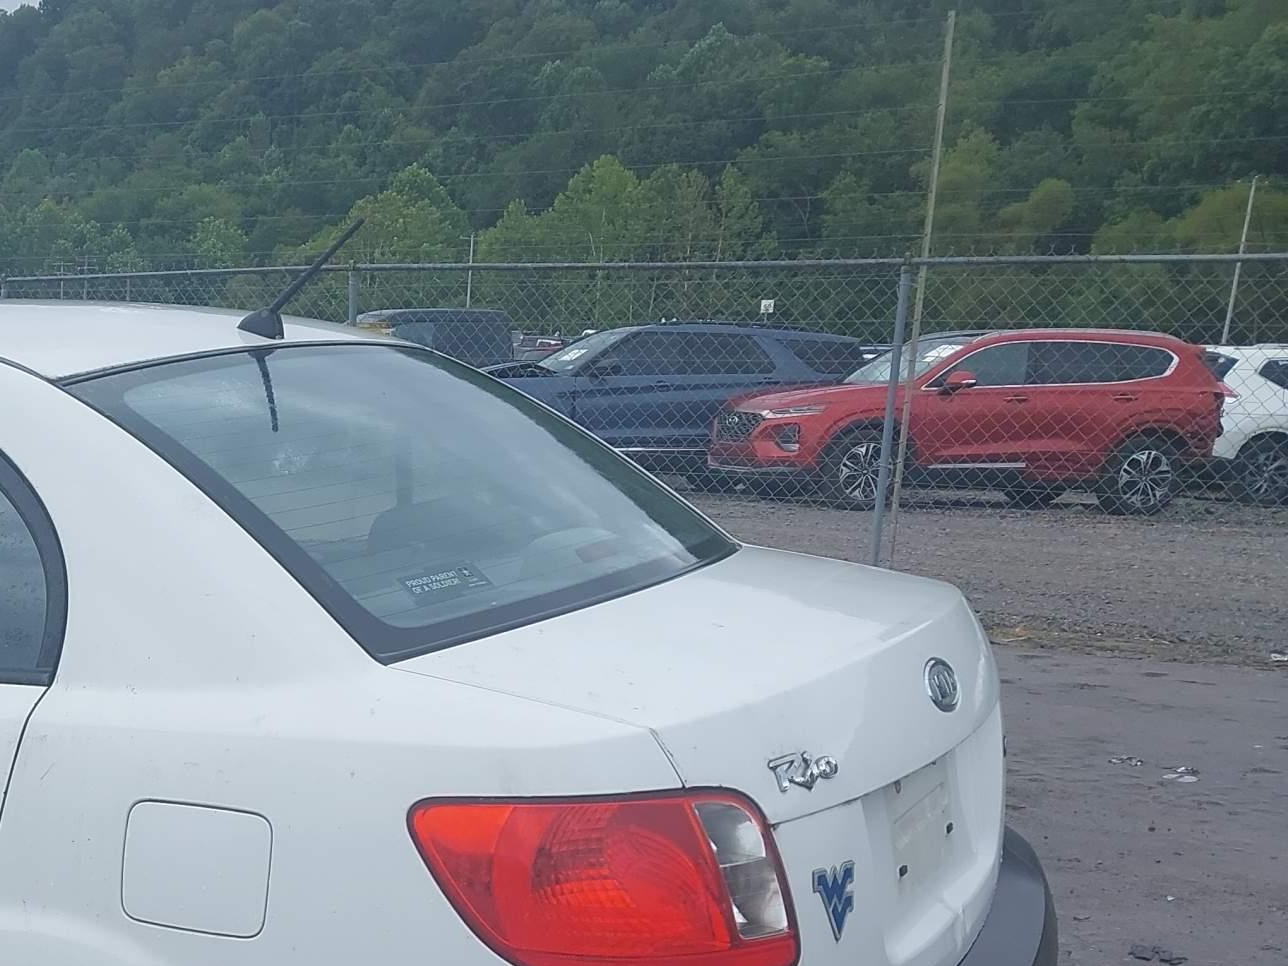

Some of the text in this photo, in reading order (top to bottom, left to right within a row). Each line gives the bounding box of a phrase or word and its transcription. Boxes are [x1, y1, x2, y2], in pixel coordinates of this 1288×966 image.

[406, 577, 431, 588] PROUD
[430, 571, 458, 582] PARENT
[413, 586, 423, 594] OF
[767, 750, 839, 793] Rio
